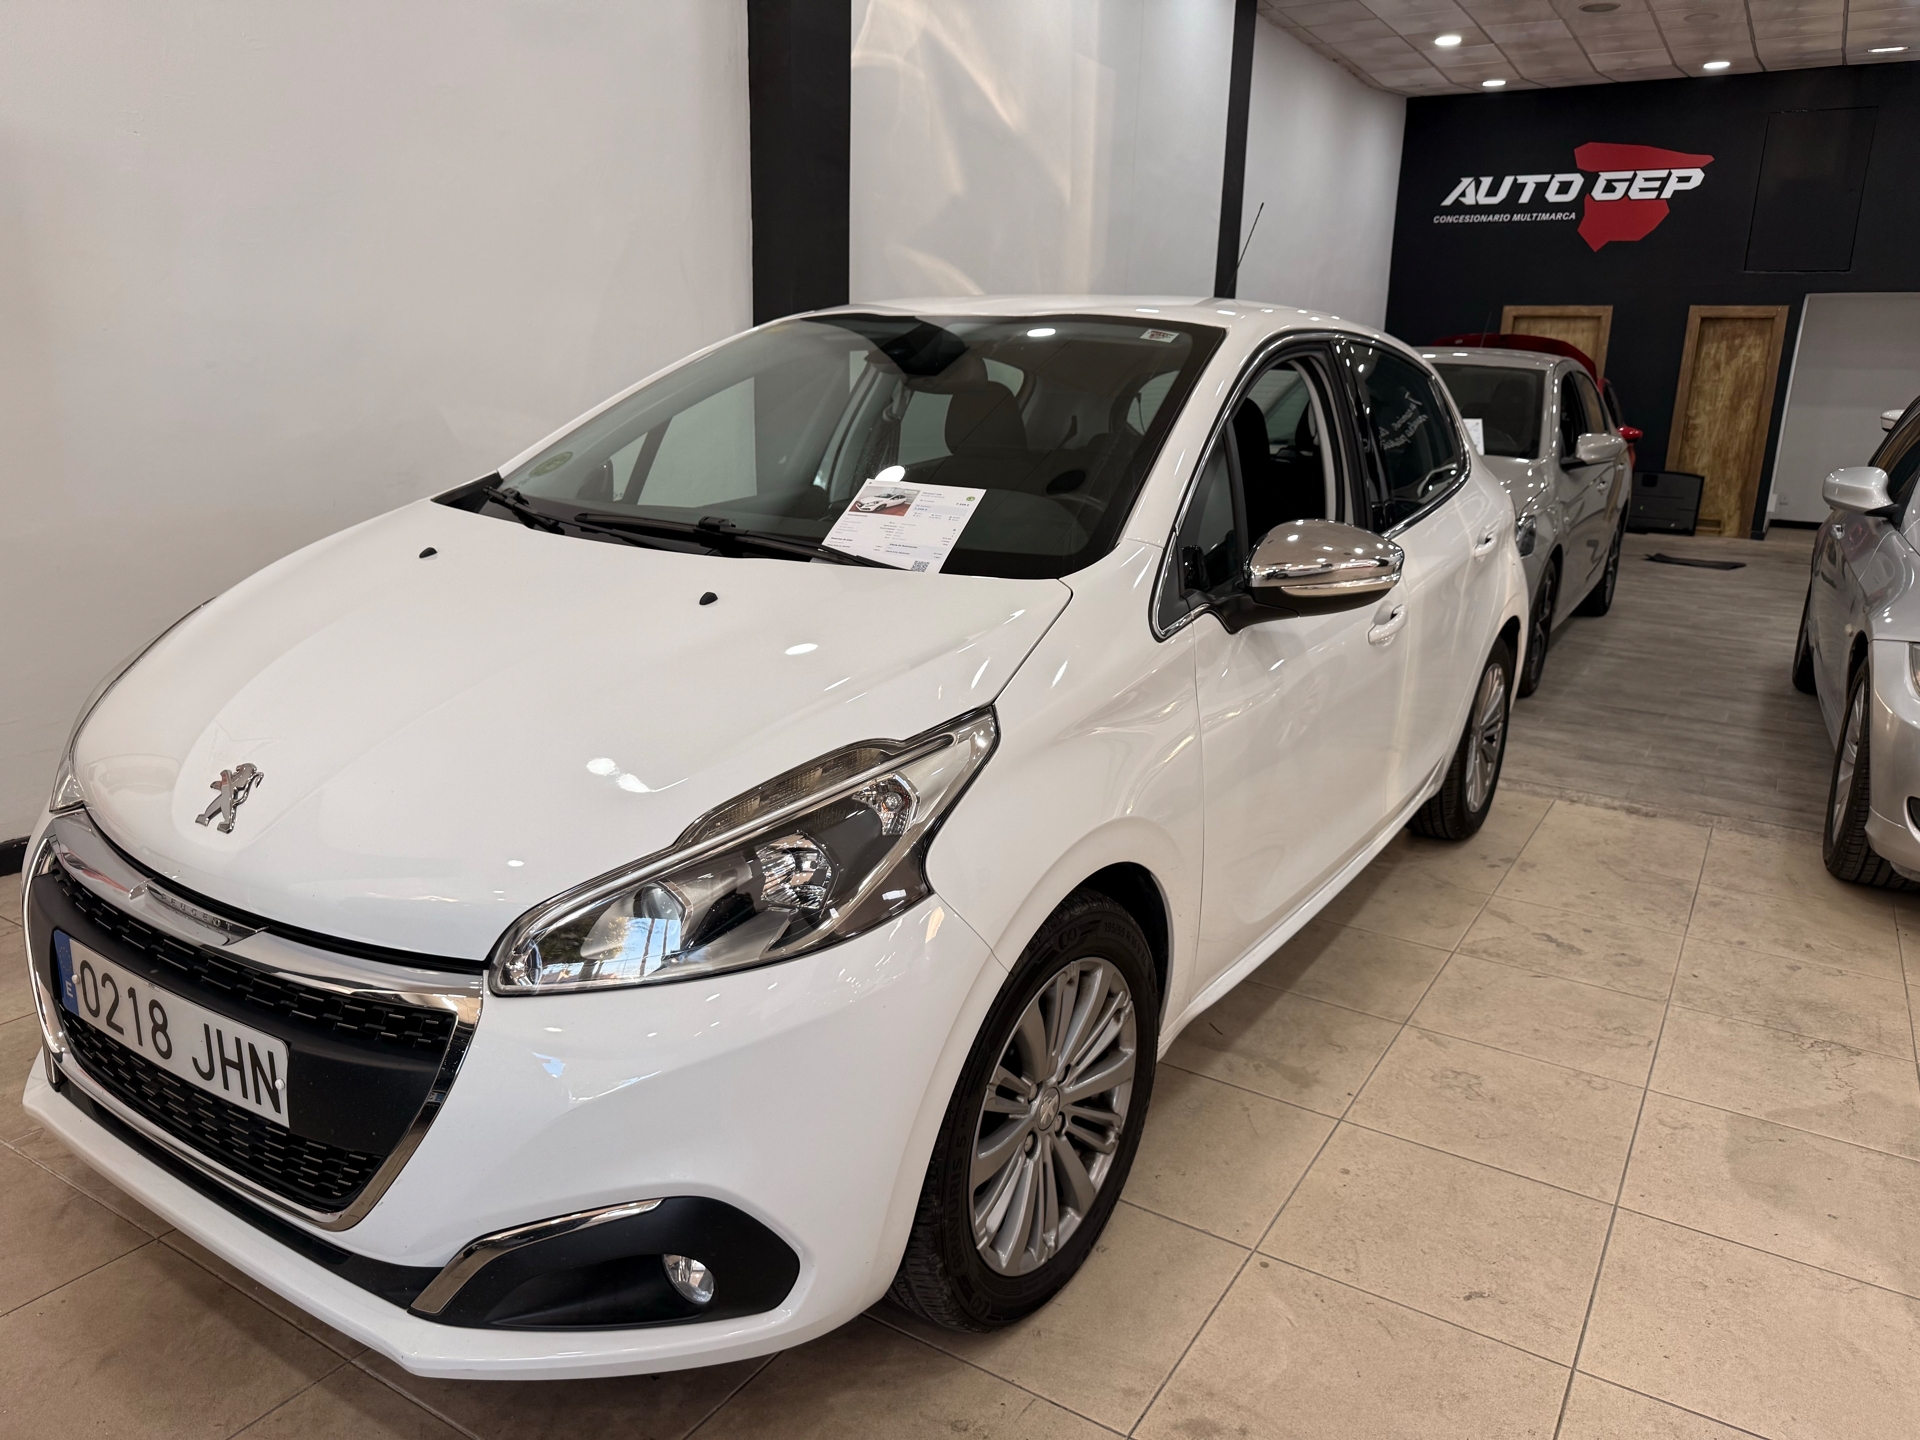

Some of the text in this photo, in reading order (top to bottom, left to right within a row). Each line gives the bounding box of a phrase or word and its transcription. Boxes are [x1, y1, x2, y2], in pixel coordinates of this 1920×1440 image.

[1440, 168, 1705, 206] AUTO GEP
[1433, 211, 1576, 224] CONCESIONARIO MULTIMARCA
[160, 892, 233, 931] PEUGEOT
[65, 981, 74, 998] E
[79, 959, 282, 1115] 0218 JHN
[948, 1156, 965, 1270] BRAVURIS
